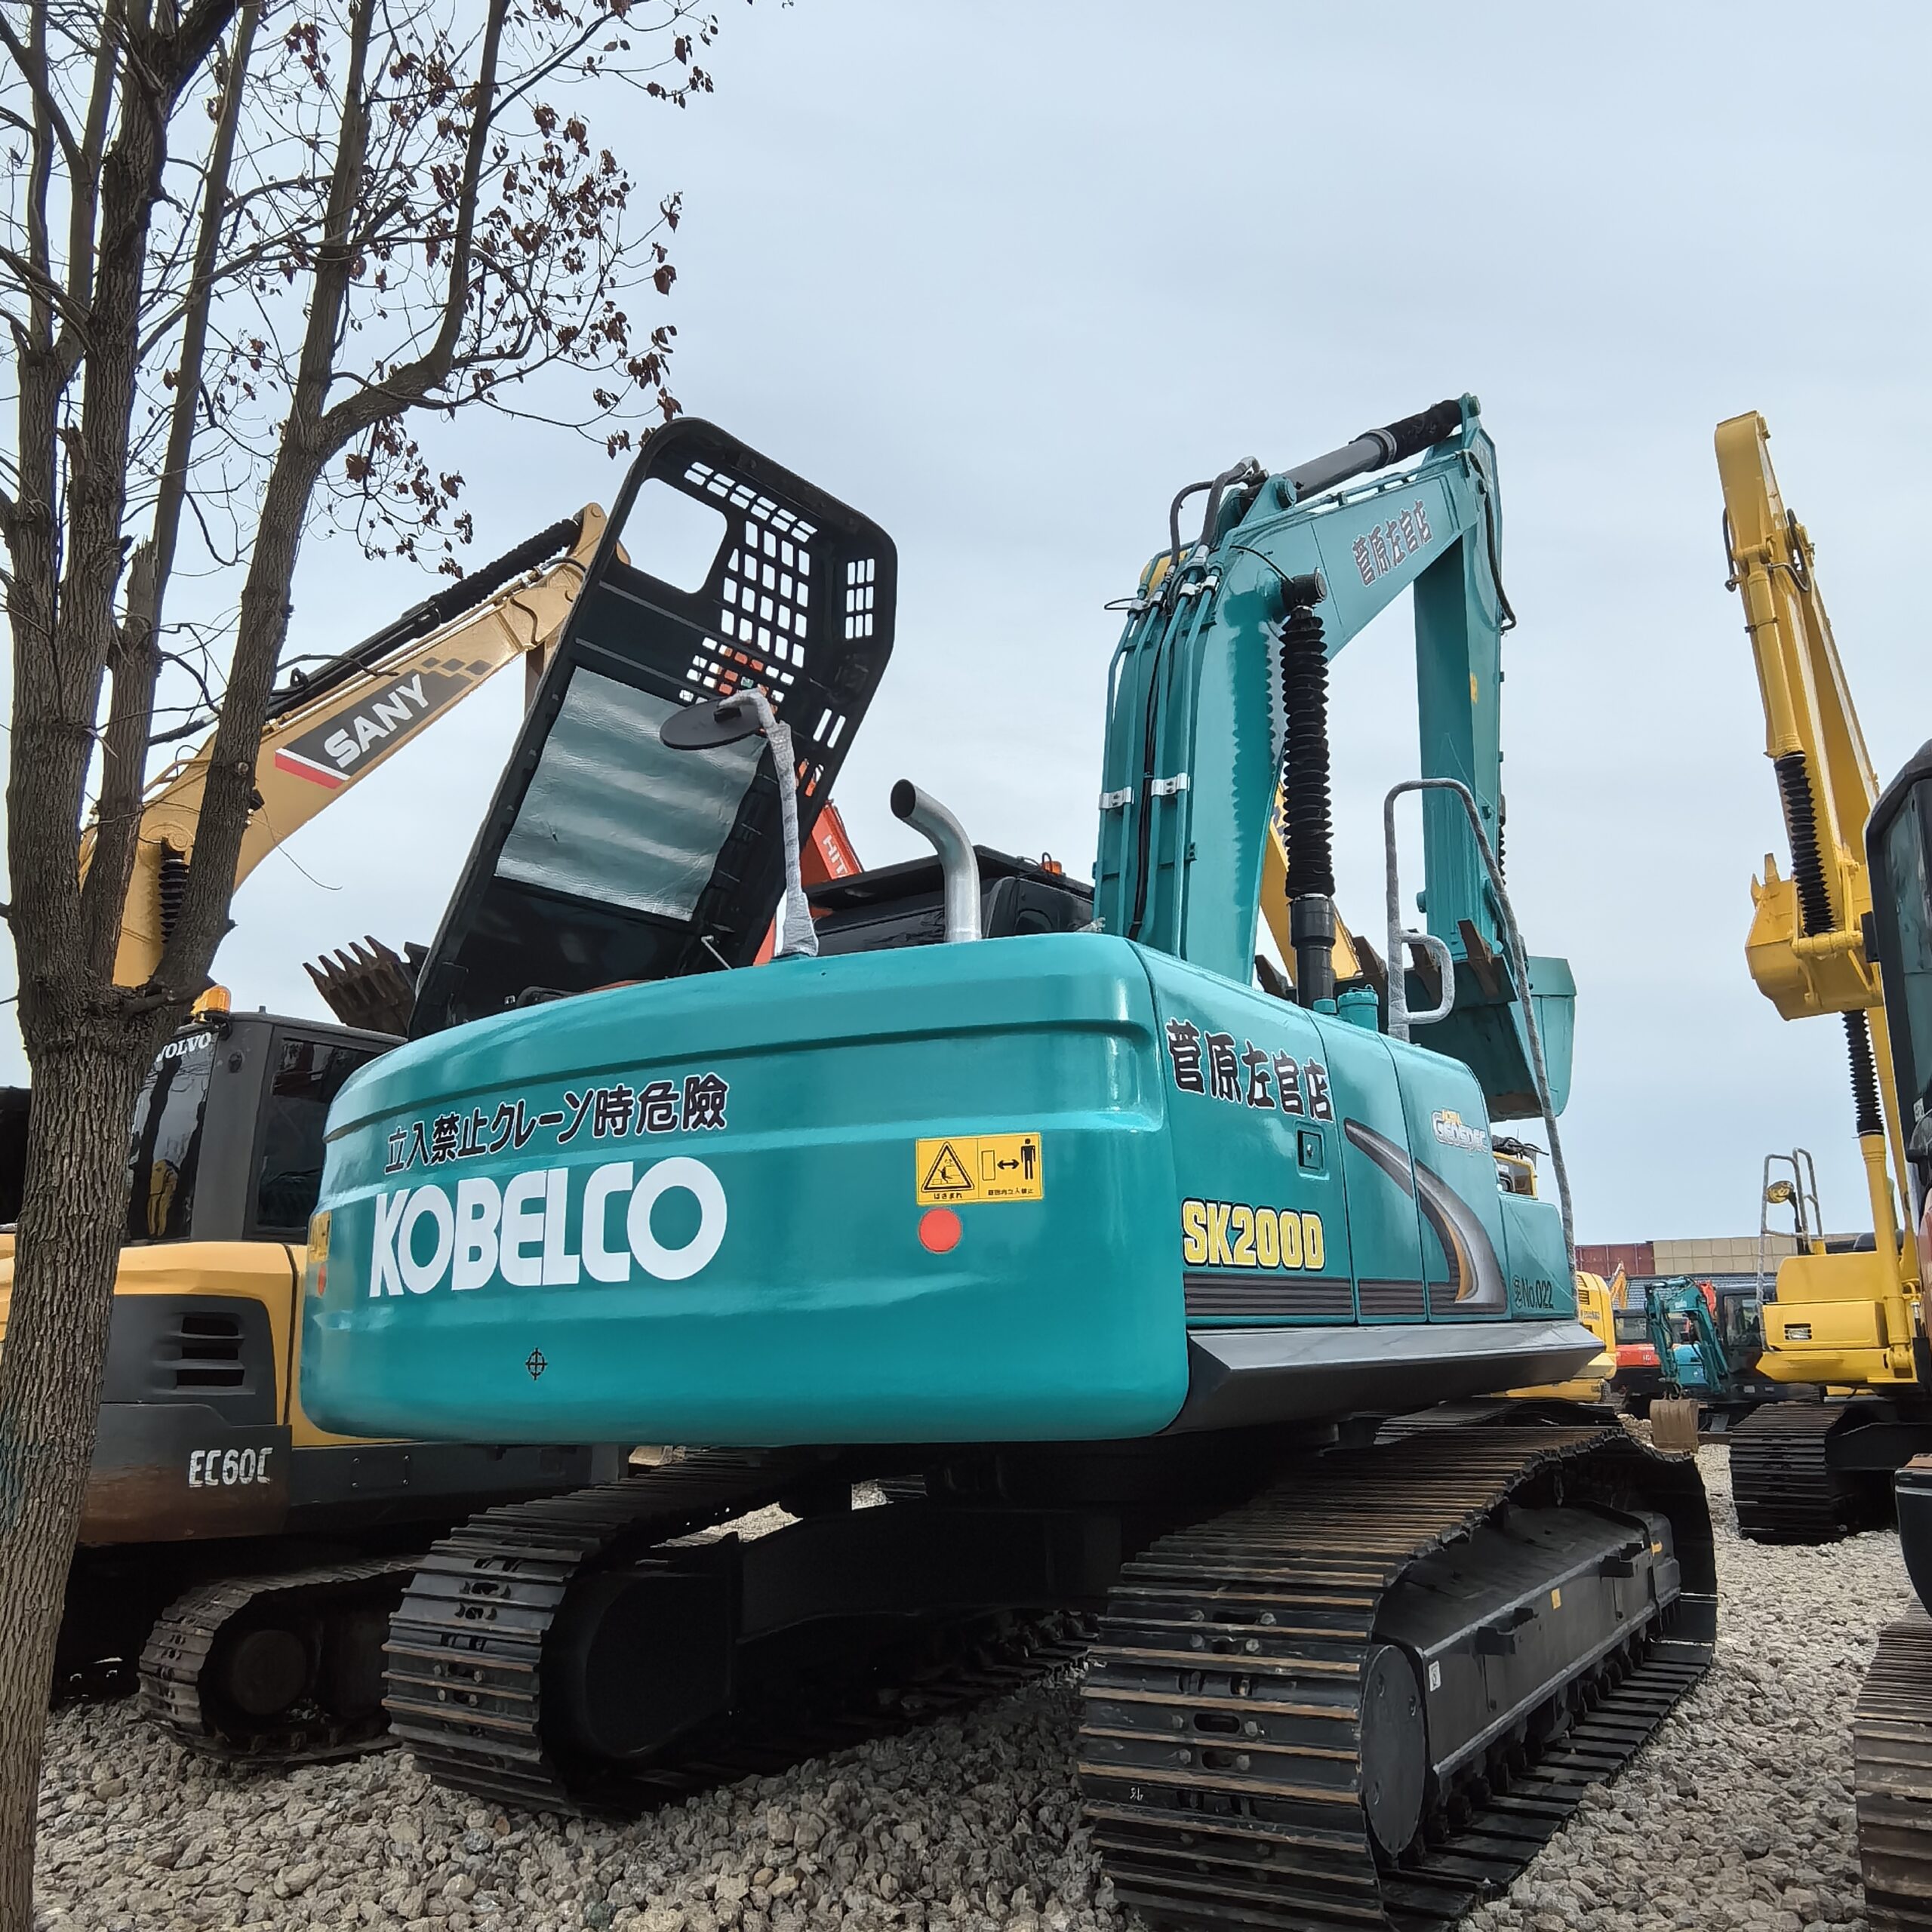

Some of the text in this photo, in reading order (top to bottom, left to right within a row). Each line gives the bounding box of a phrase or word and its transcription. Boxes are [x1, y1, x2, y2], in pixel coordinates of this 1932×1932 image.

[324, 673, 429, 768] SANY
[369, 1156, 728, 1298] KOBELCO
[1182, 1197, 1325, 1271] SK200D
[189, 1447, 273, 1487] EC60C
